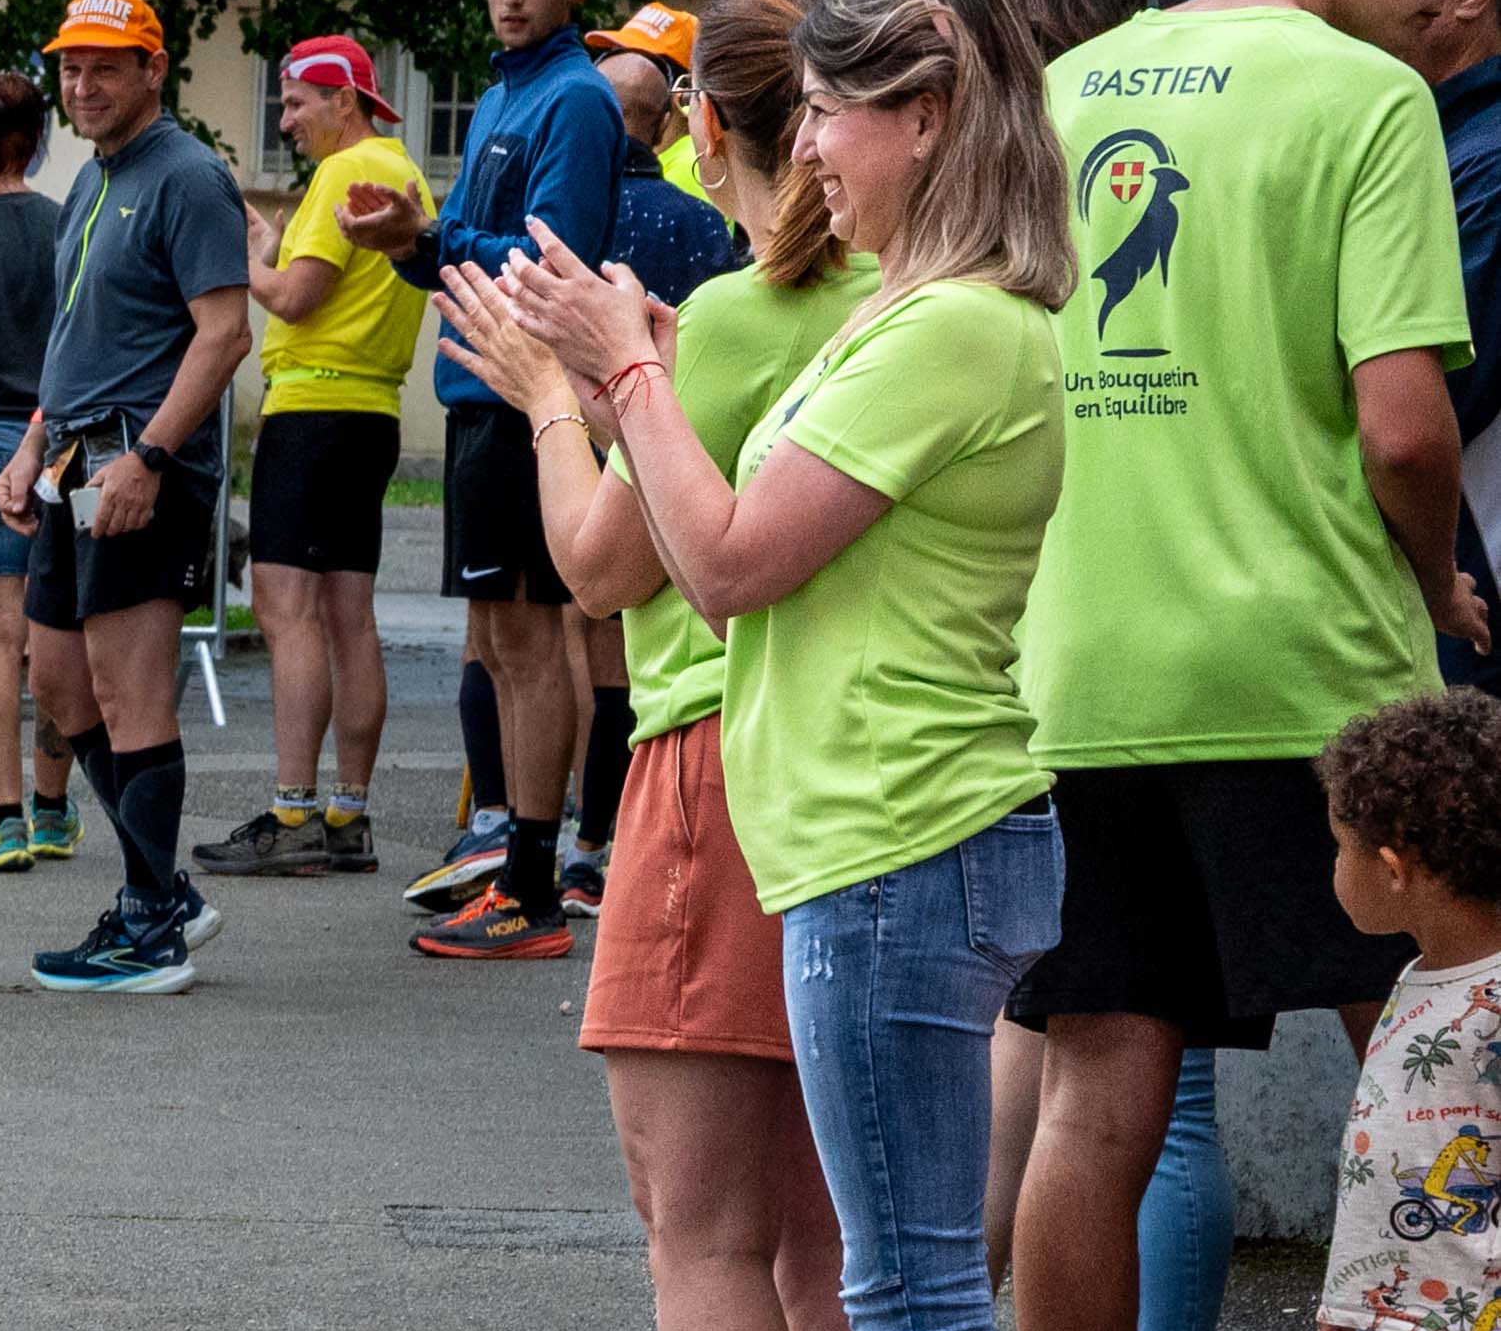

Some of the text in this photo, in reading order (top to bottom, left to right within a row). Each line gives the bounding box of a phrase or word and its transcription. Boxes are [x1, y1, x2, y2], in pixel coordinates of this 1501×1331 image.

[1080, 65, 1232, 98] BASTIEN
[1065, 366, 1199, 394] Un Bouquetin
[1074, 394, 1188, 421] en Equilibre
[485, 915, 529, 938] HOKA
[1406, 1108, 1435, 1122] Léo
[1440, 1104, 1482, 1120] part
